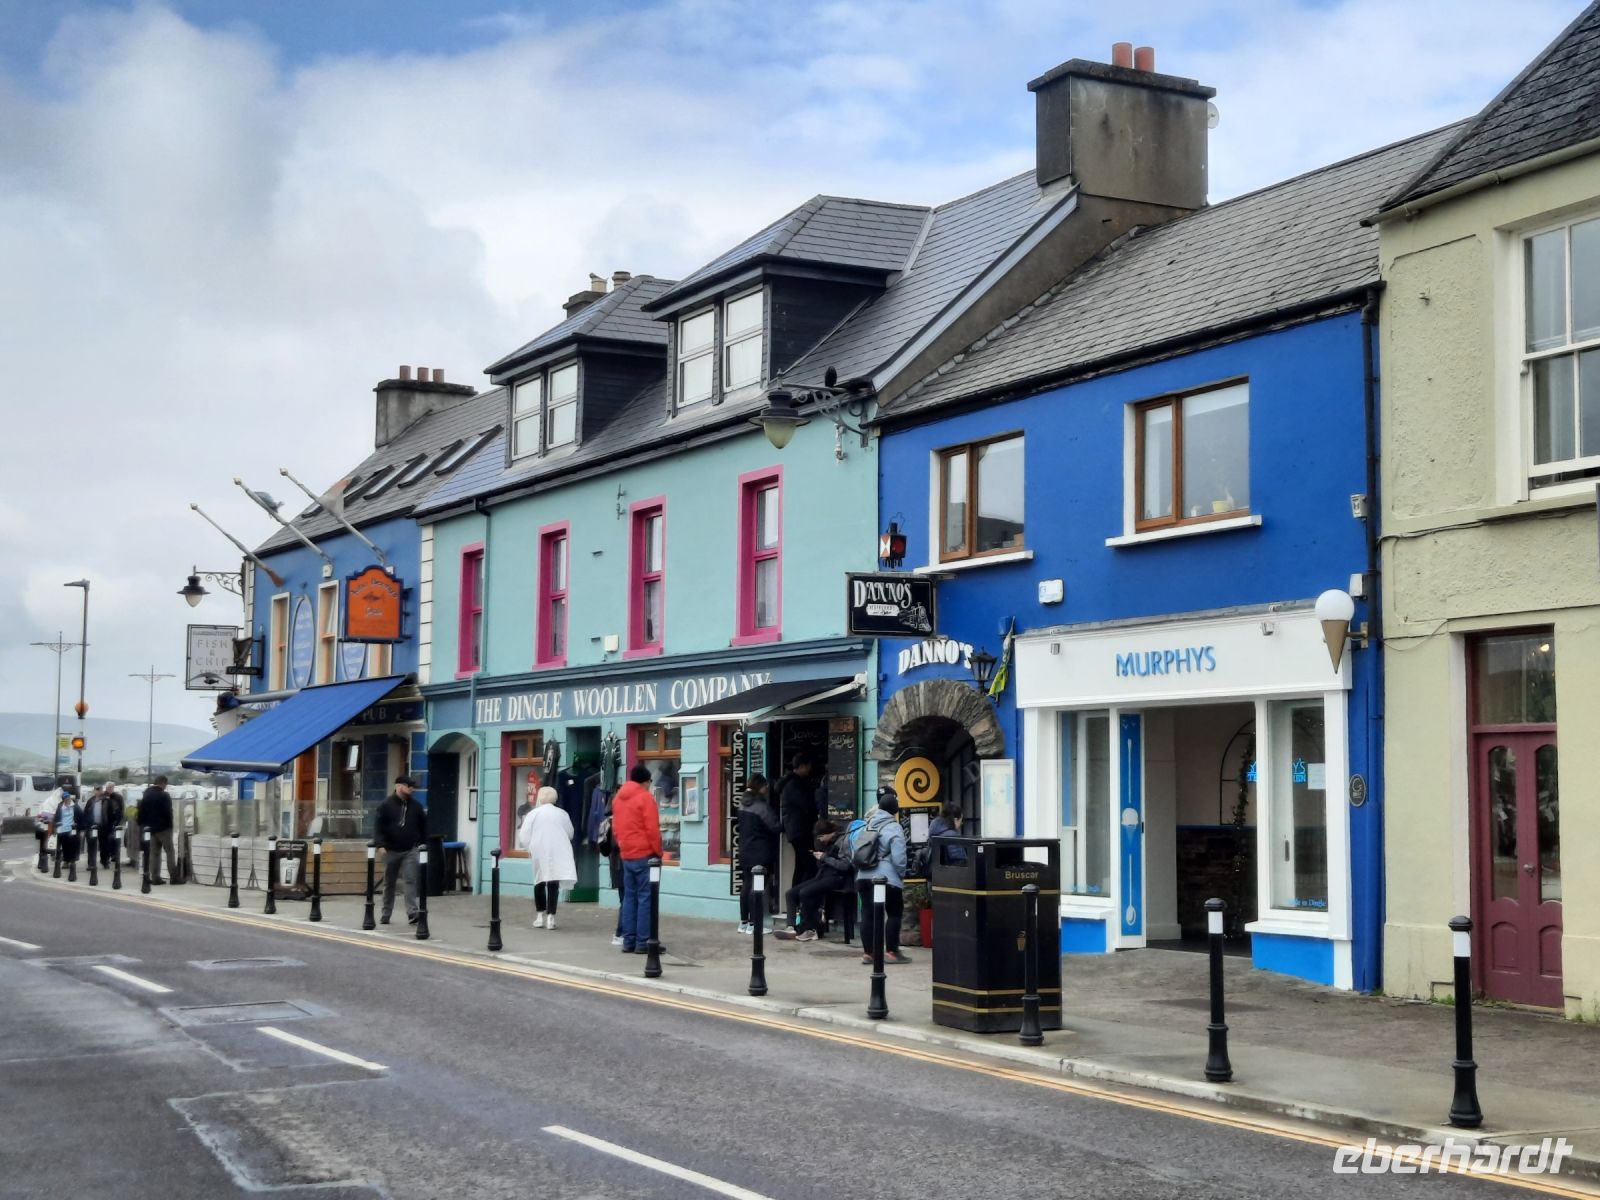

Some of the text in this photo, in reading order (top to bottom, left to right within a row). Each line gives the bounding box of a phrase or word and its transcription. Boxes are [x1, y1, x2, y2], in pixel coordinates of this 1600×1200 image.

[854, 579, 912, 608] DANNO'S
[898, 639, 974, 675] DANNO'S
[1115, 646, 1216, 677] MURPHYS
[363, 707, 387, 721] PUB
[476, 698, 502, 724] THE
[508, 691, 563, 721] DINGLE
[573, 683, 659, 715] WOOLLEN
[1005, 870, 1039, 880] Bruscar
